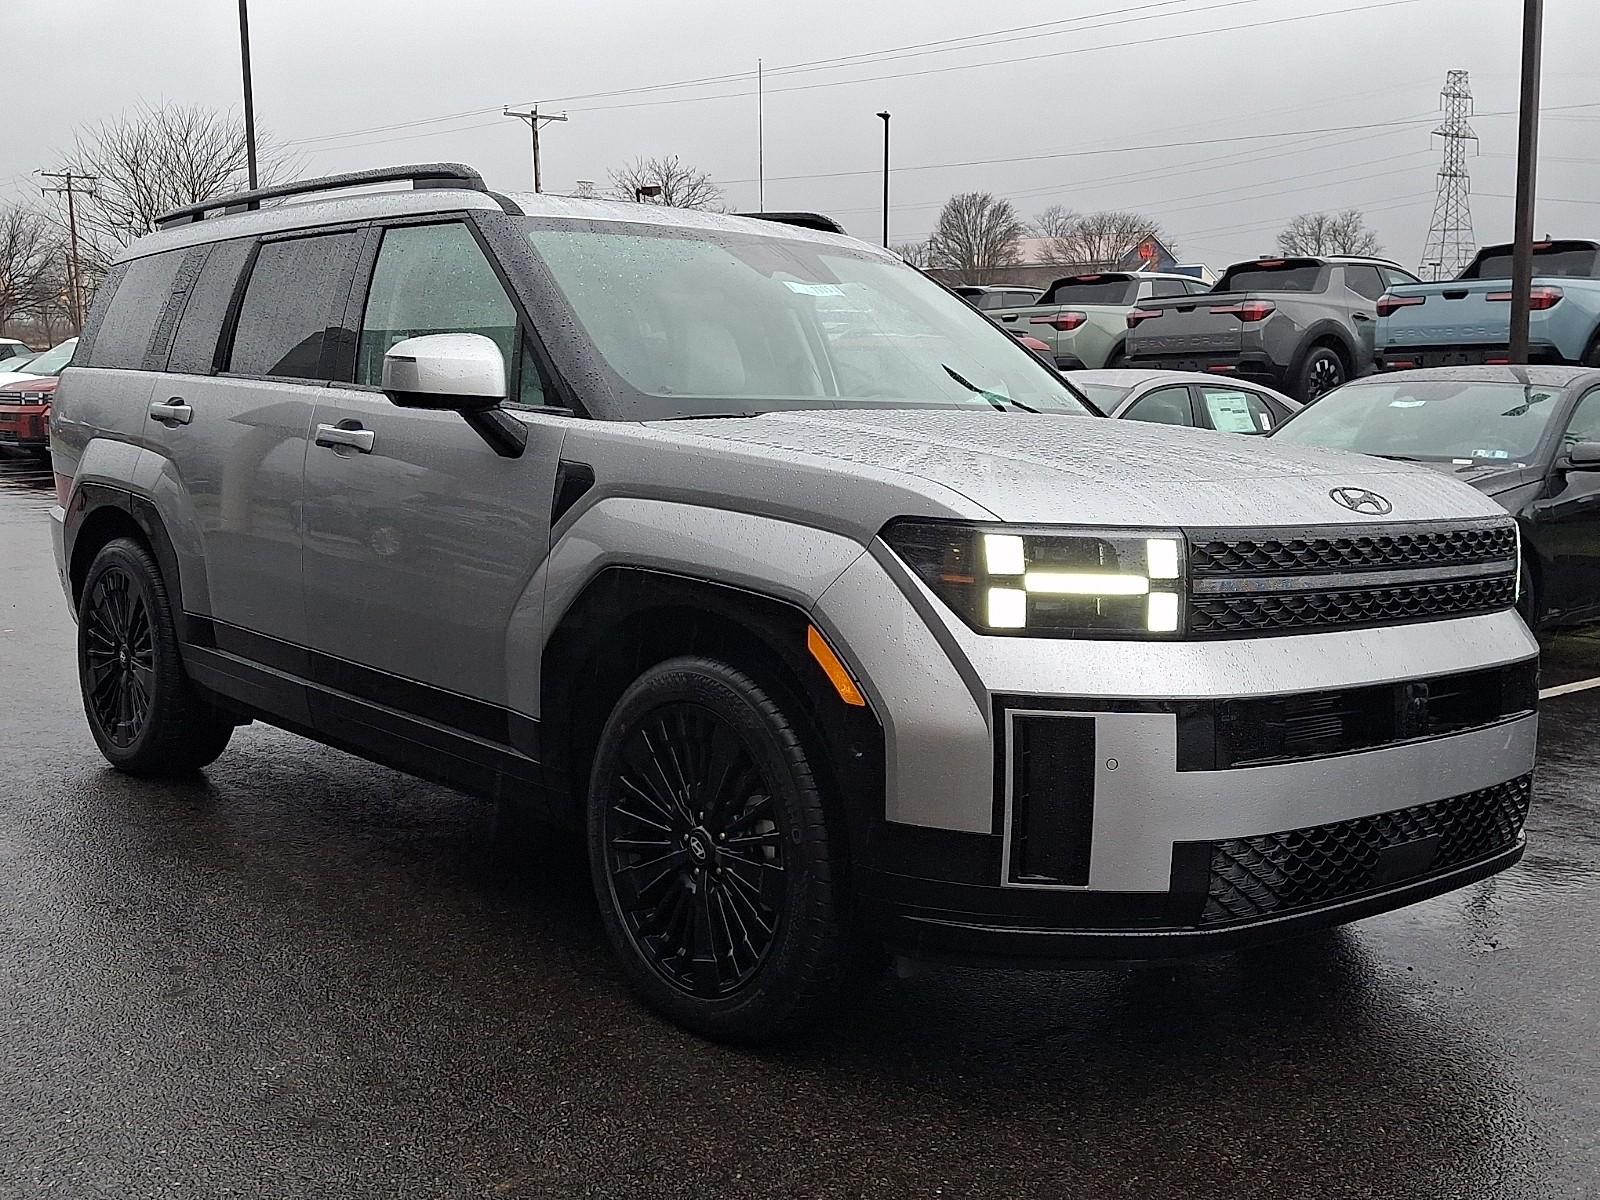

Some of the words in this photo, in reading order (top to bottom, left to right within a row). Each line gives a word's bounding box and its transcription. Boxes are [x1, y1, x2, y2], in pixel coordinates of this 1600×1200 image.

[1394, 327, 1455, 339] SANTA
[1139, 338, 1186, 349] SANTA
[1191, 335, 1235, 346] CRUZ
